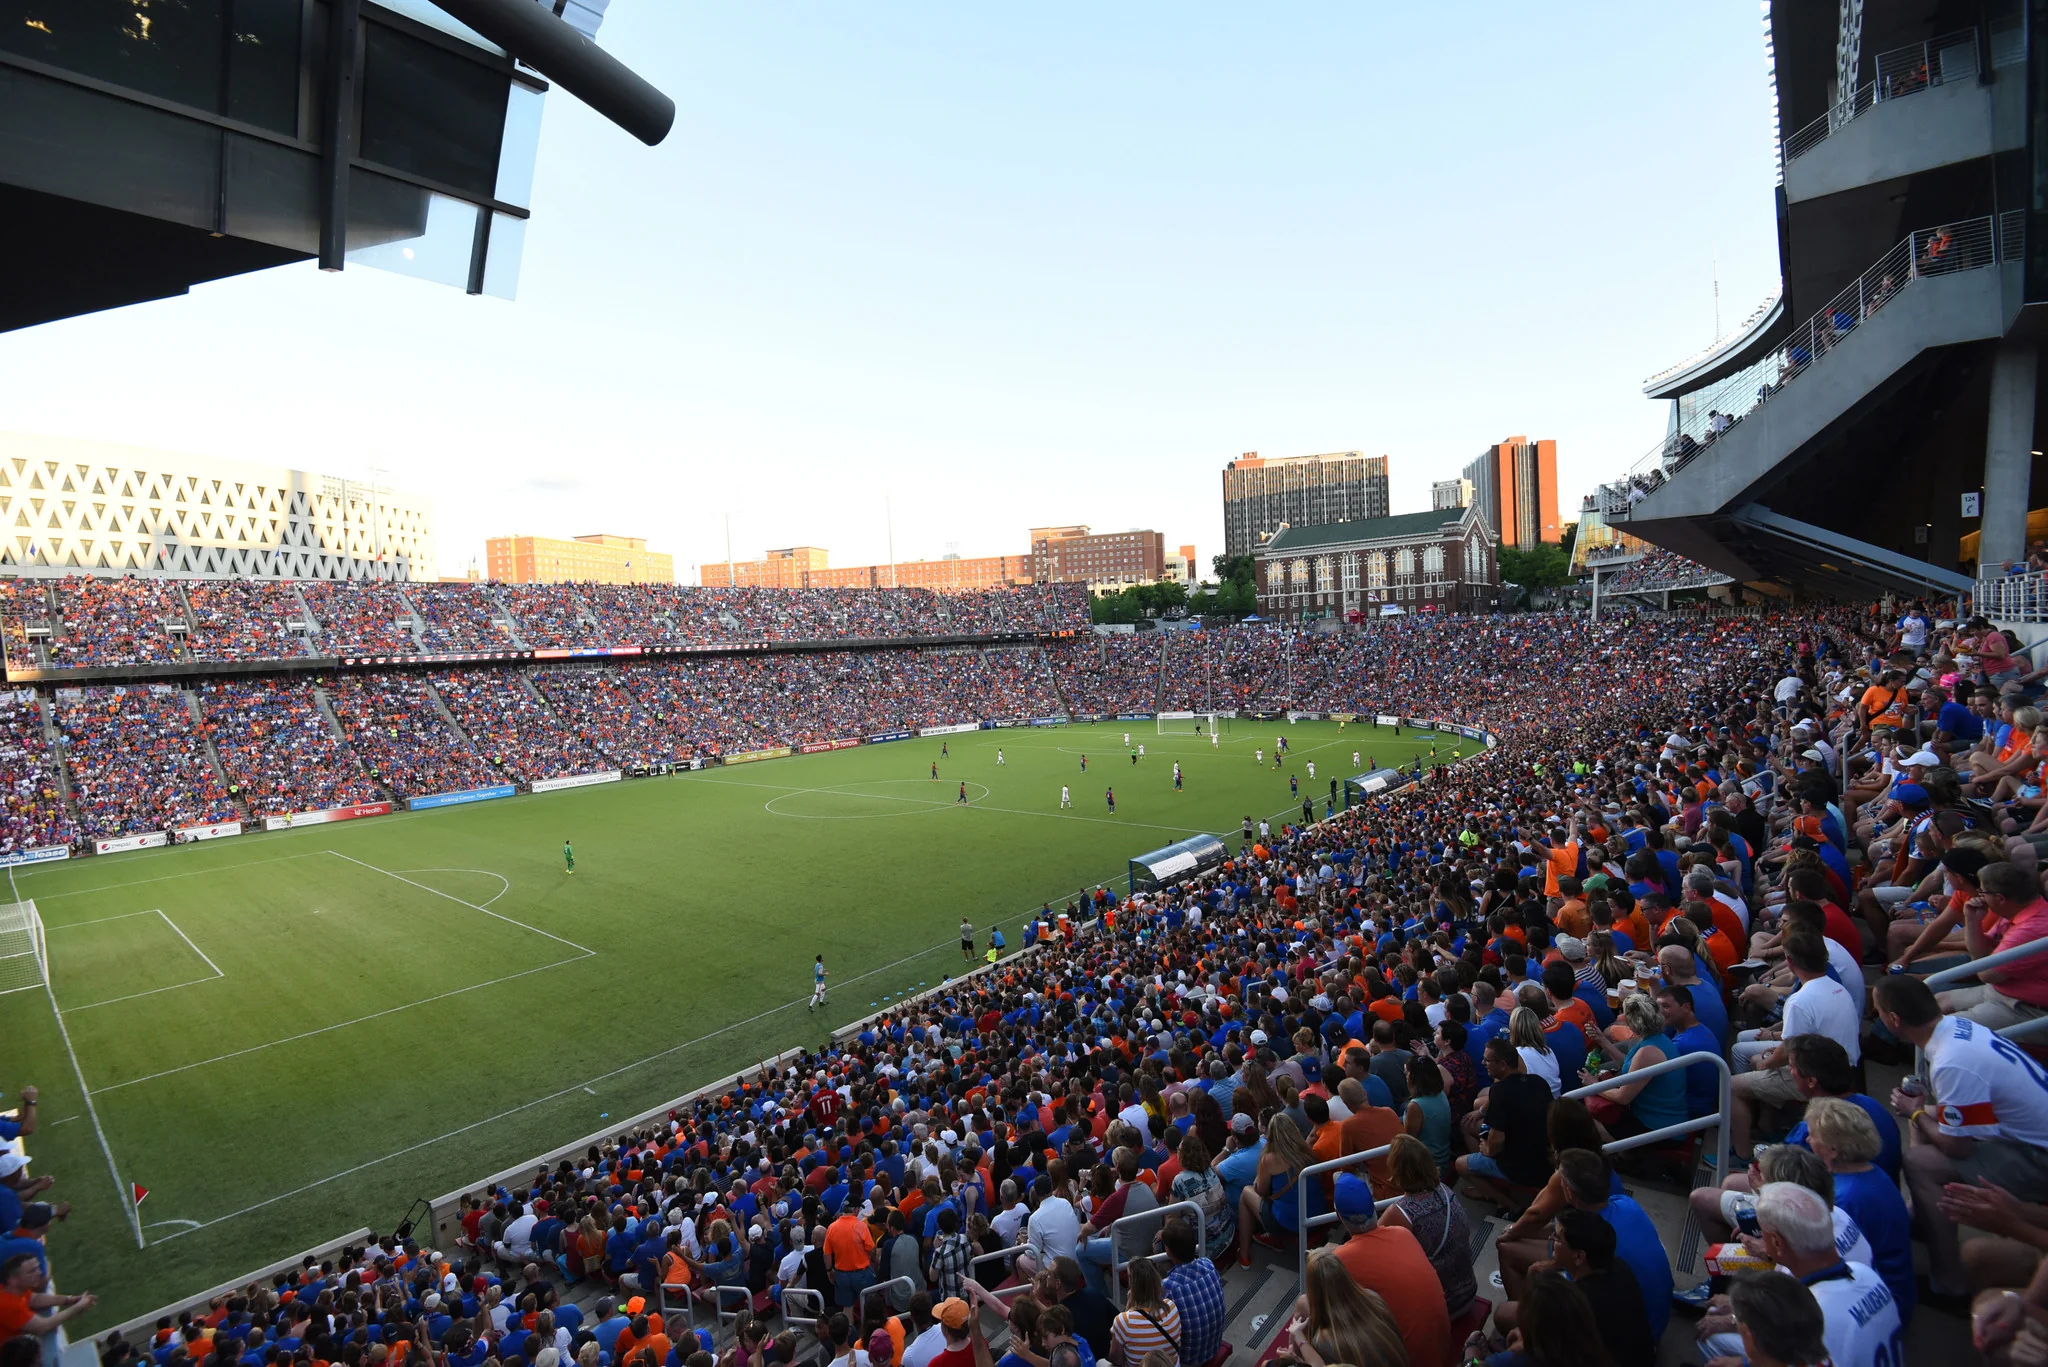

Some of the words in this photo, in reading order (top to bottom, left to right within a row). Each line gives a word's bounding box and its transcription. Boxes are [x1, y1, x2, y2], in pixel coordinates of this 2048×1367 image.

[811, 744, 831, 752] TOYOTA
[476, 790, 497, 798] Together
[363, 806, 383, 814] Health
[821, 1099, 832, 1115] 11
